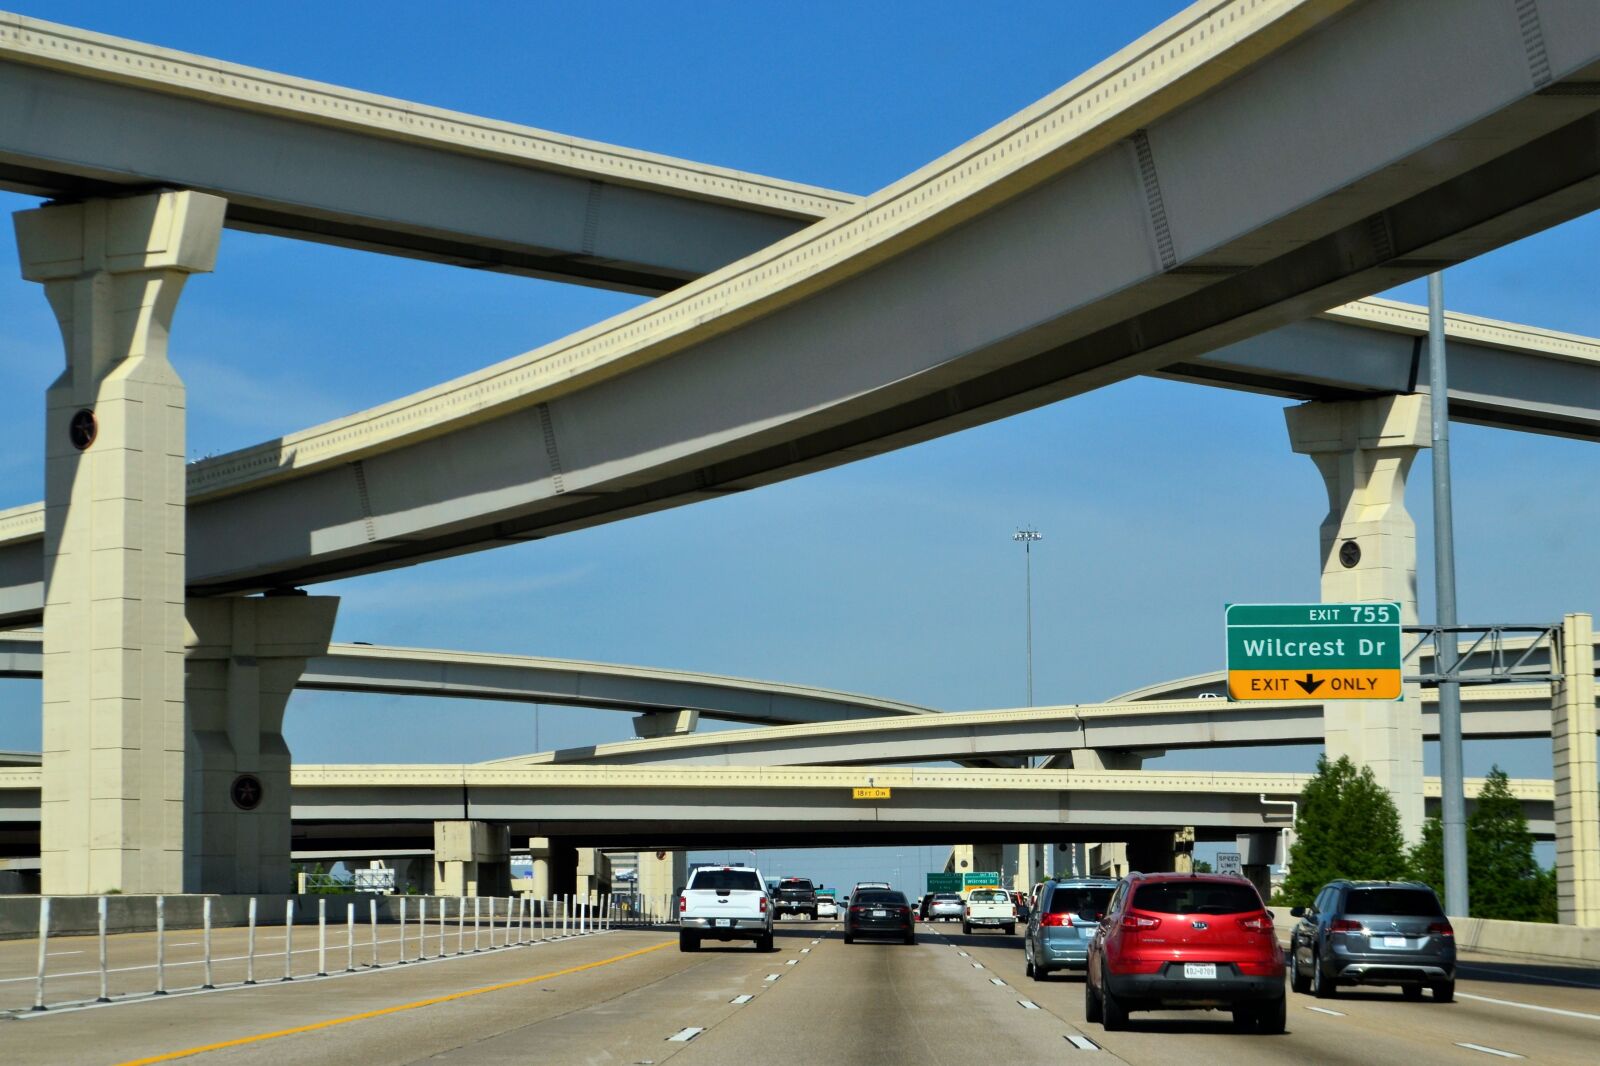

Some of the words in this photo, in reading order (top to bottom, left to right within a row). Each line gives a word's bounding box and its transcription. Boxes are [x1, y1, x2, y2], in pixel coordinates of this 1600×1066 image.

[1309, 609, 1340, 621] EXIT
[1350, 606, 1390, 623] 755
[1243, 638, 1345, 657] Wilcrest
[1359, 638, 1386, 656] Dr
[1251, 678, 1290, 691] EXIT
[1331, 677, 1378, 690] ONLY
